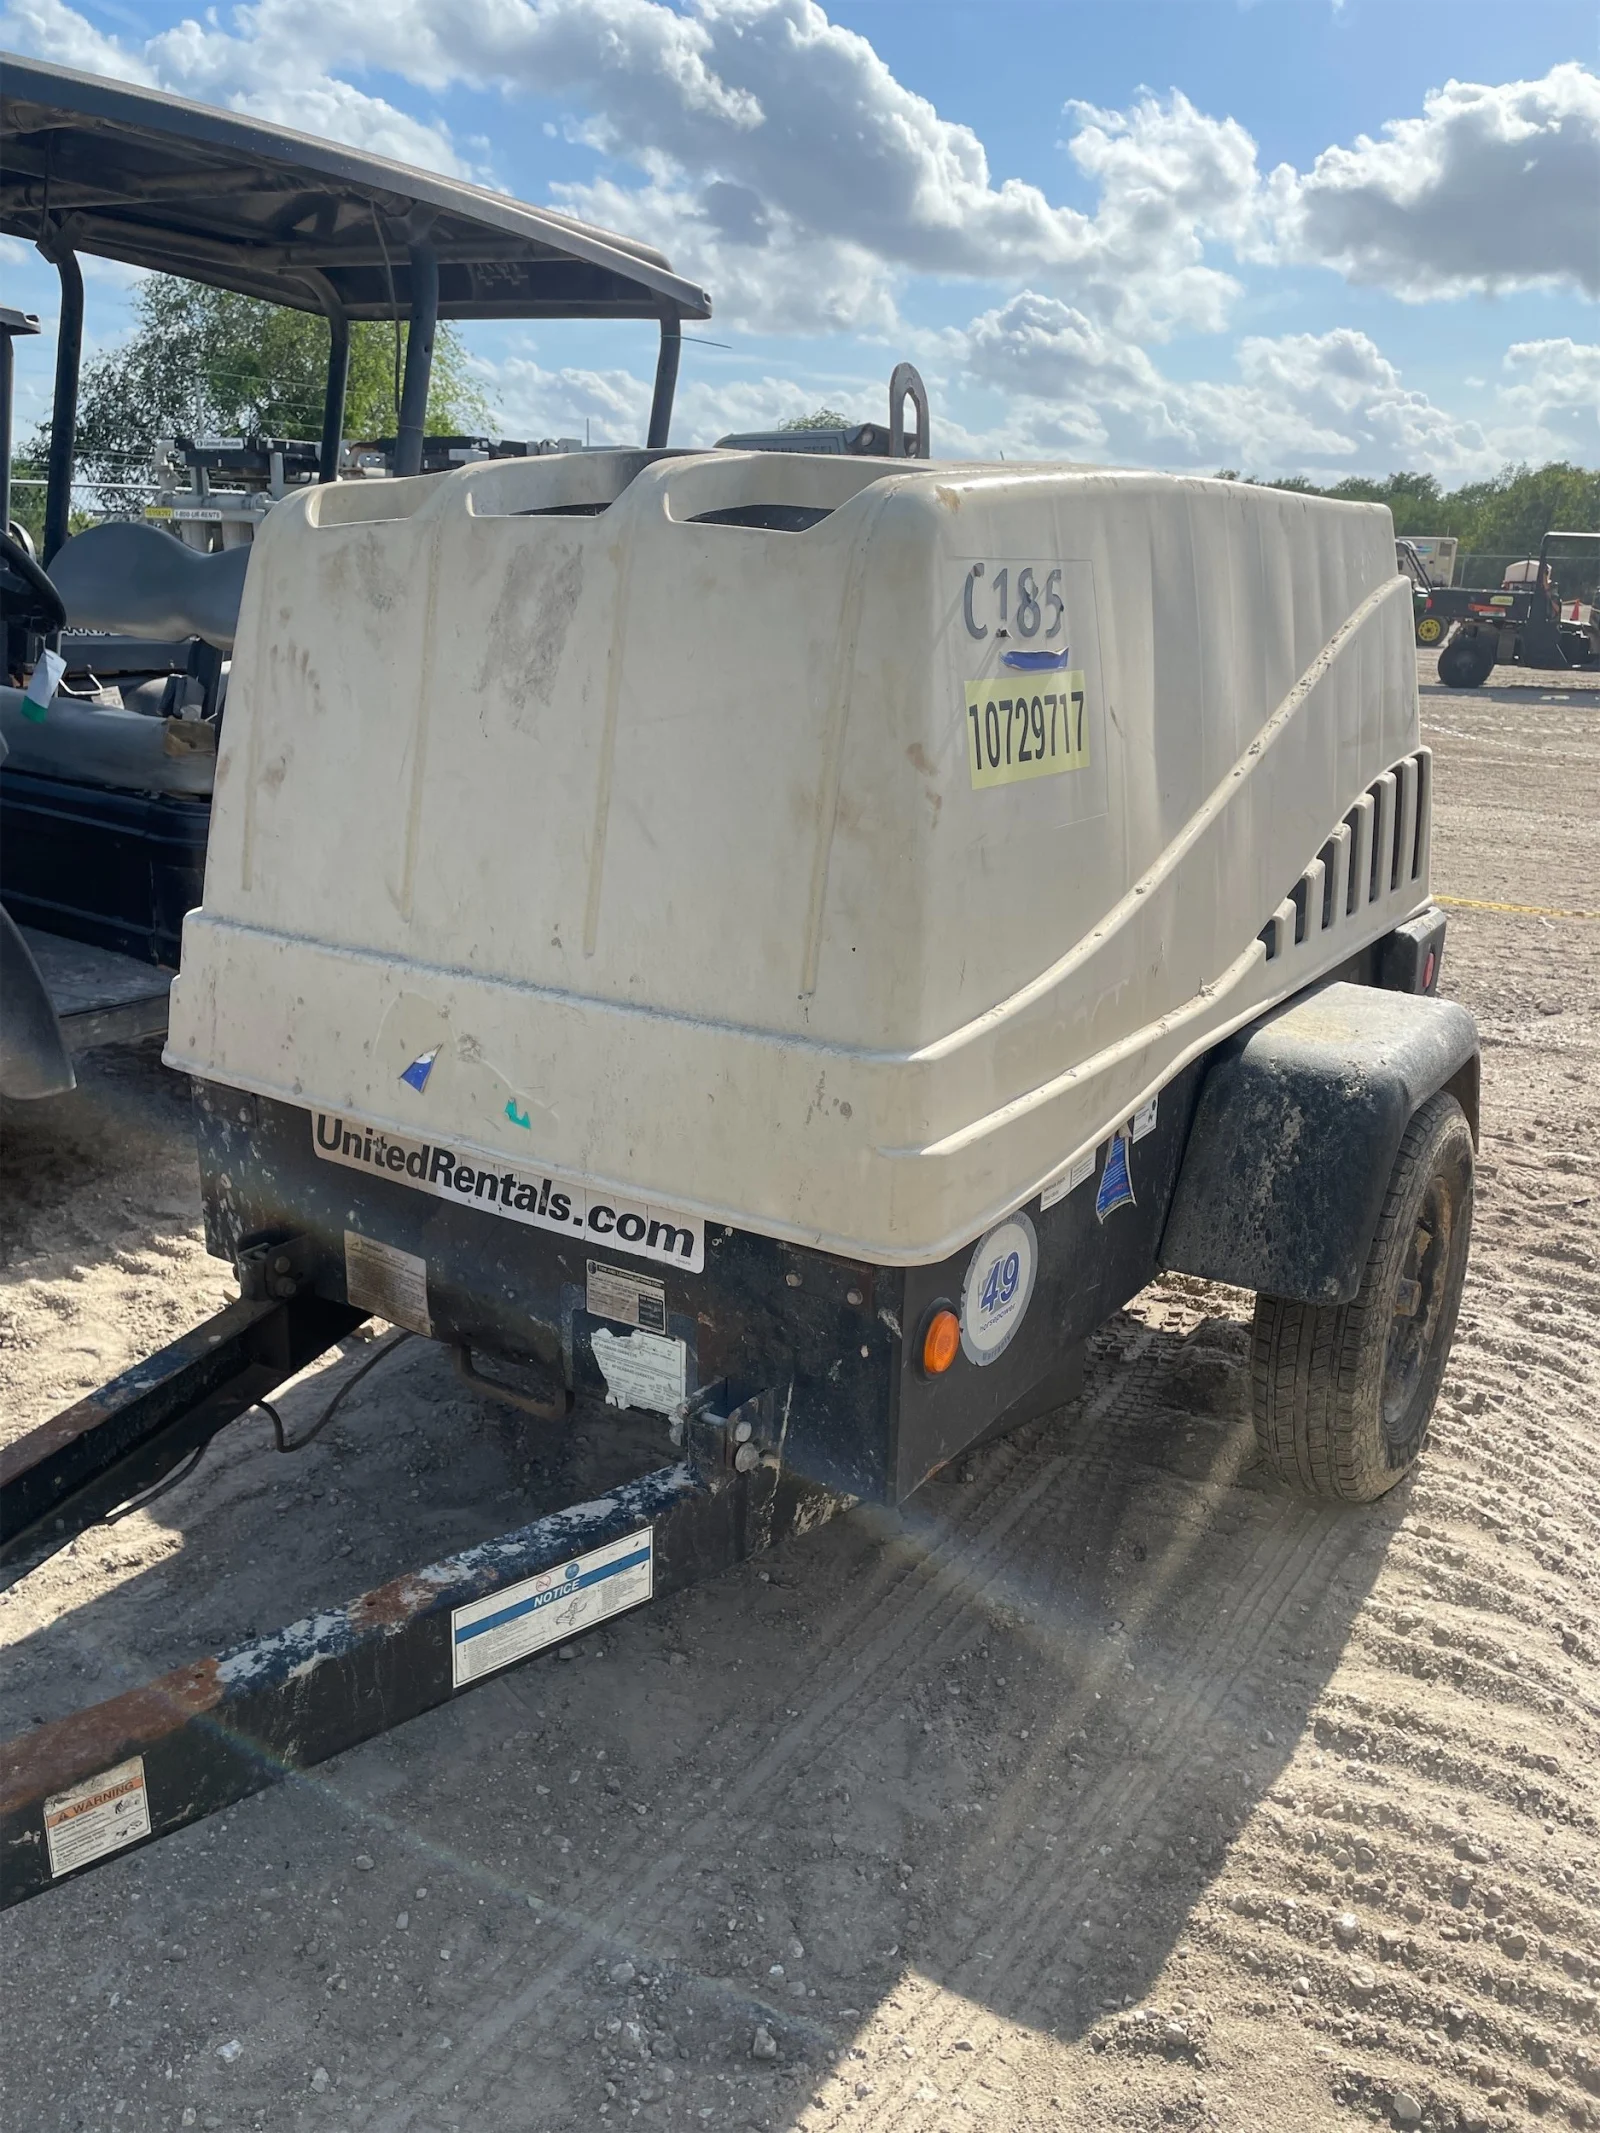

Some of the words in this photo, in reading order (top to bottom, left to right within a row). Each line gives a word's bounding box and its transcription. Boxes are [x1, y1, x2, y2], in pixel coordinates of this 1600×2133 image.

[968, 690, 1085, 770] 10729717
[315, 1113, 695, 1259] UnitedRentals.com
[980, 1251, 1020, 1313] 49
[979, 1302, 1016, 1332] horsepower
[533, 1578, 581, 1609] NOTICE
[73, 1781, 134, 1814] WARNING
